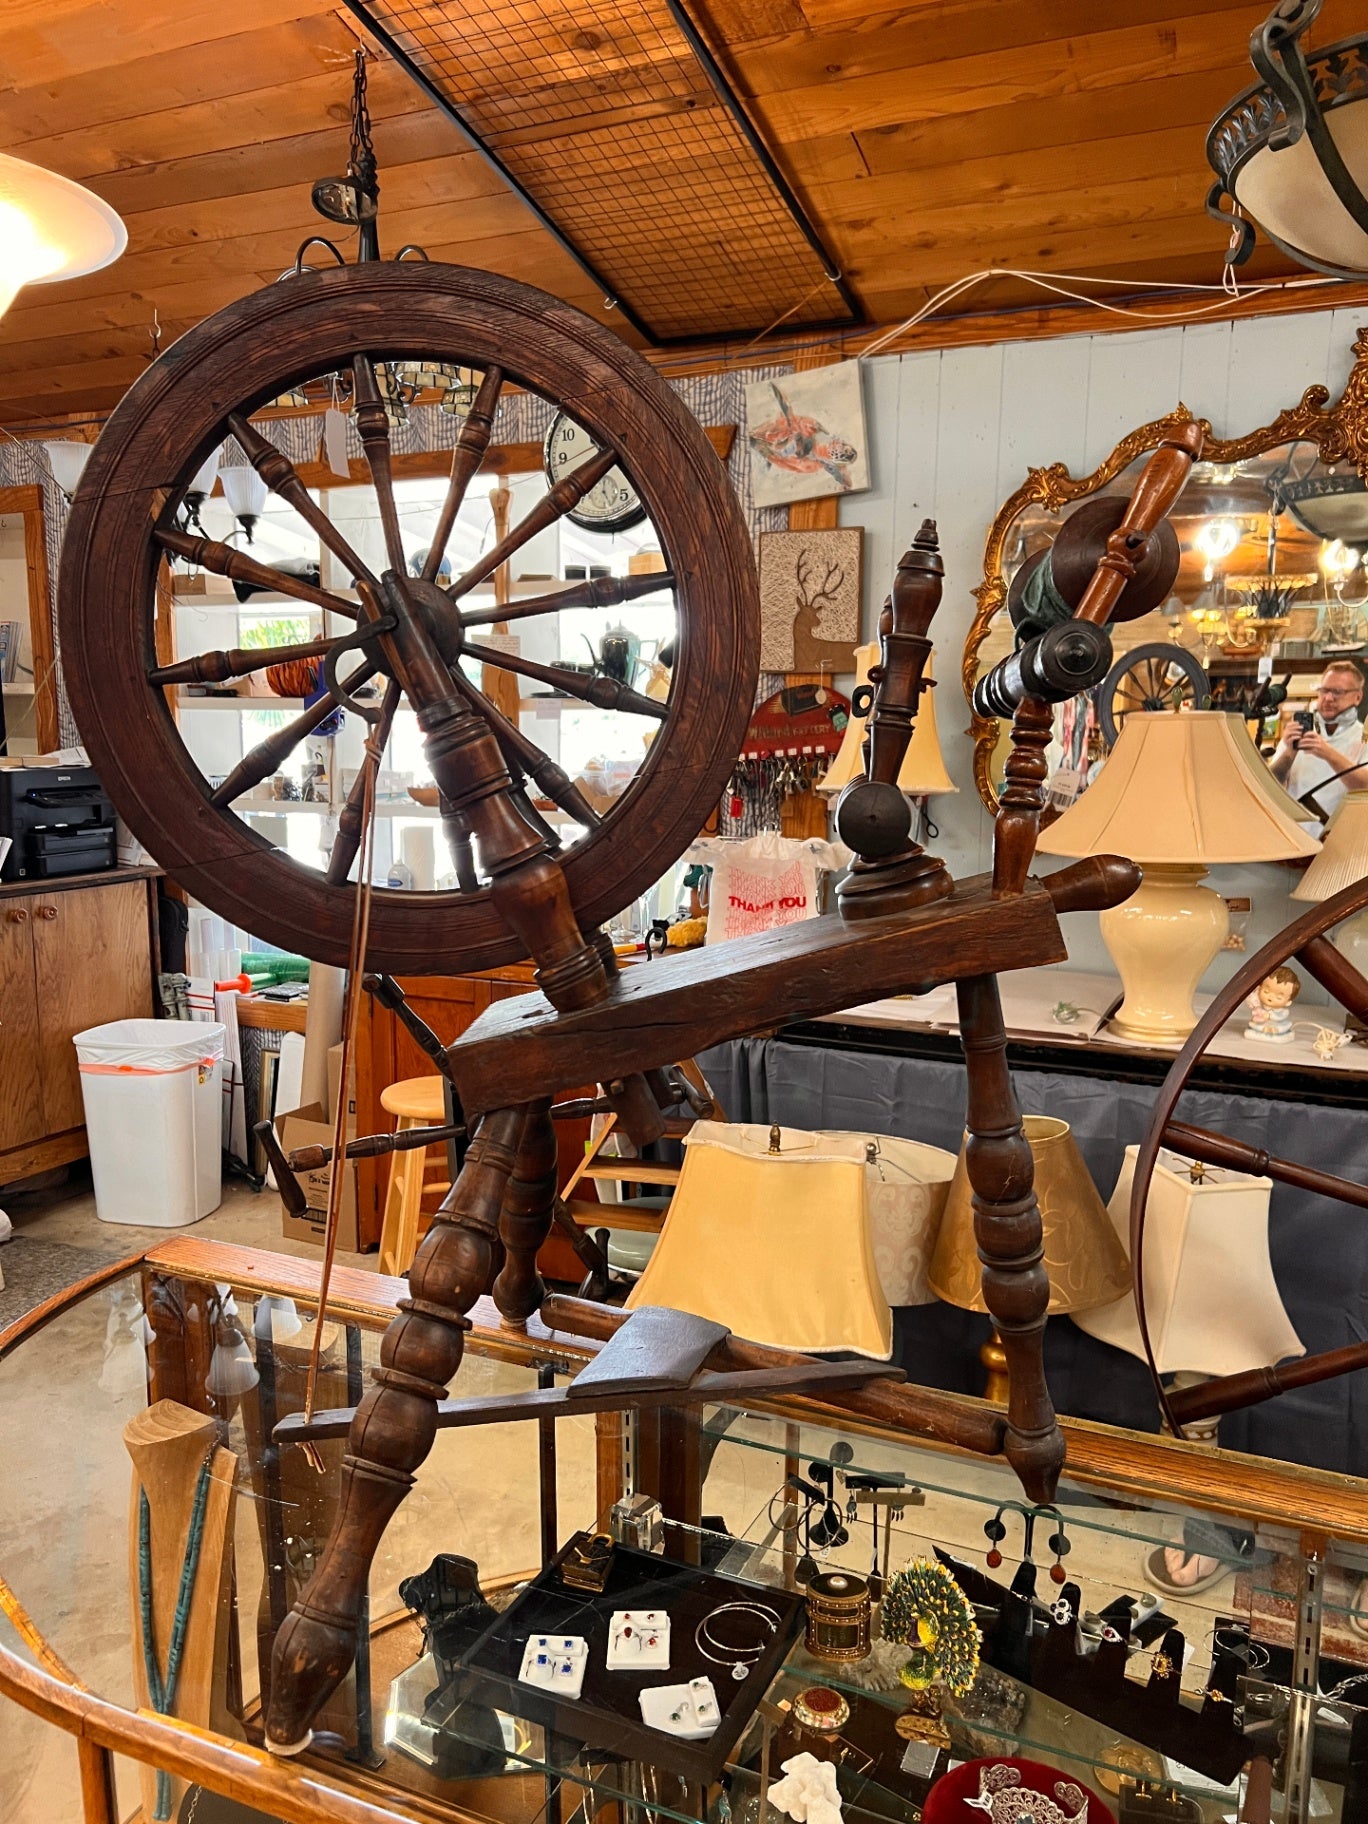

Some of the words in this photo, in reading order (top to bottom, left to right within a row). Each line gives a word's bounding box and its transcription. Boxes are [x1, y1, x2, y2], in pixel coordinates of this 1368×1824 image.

[561, 428, 575, 441] 10
[558, 452, 568, 465] 9
[619, 488, 629, 501] 5
[779, 896, 807, 909] YOU
